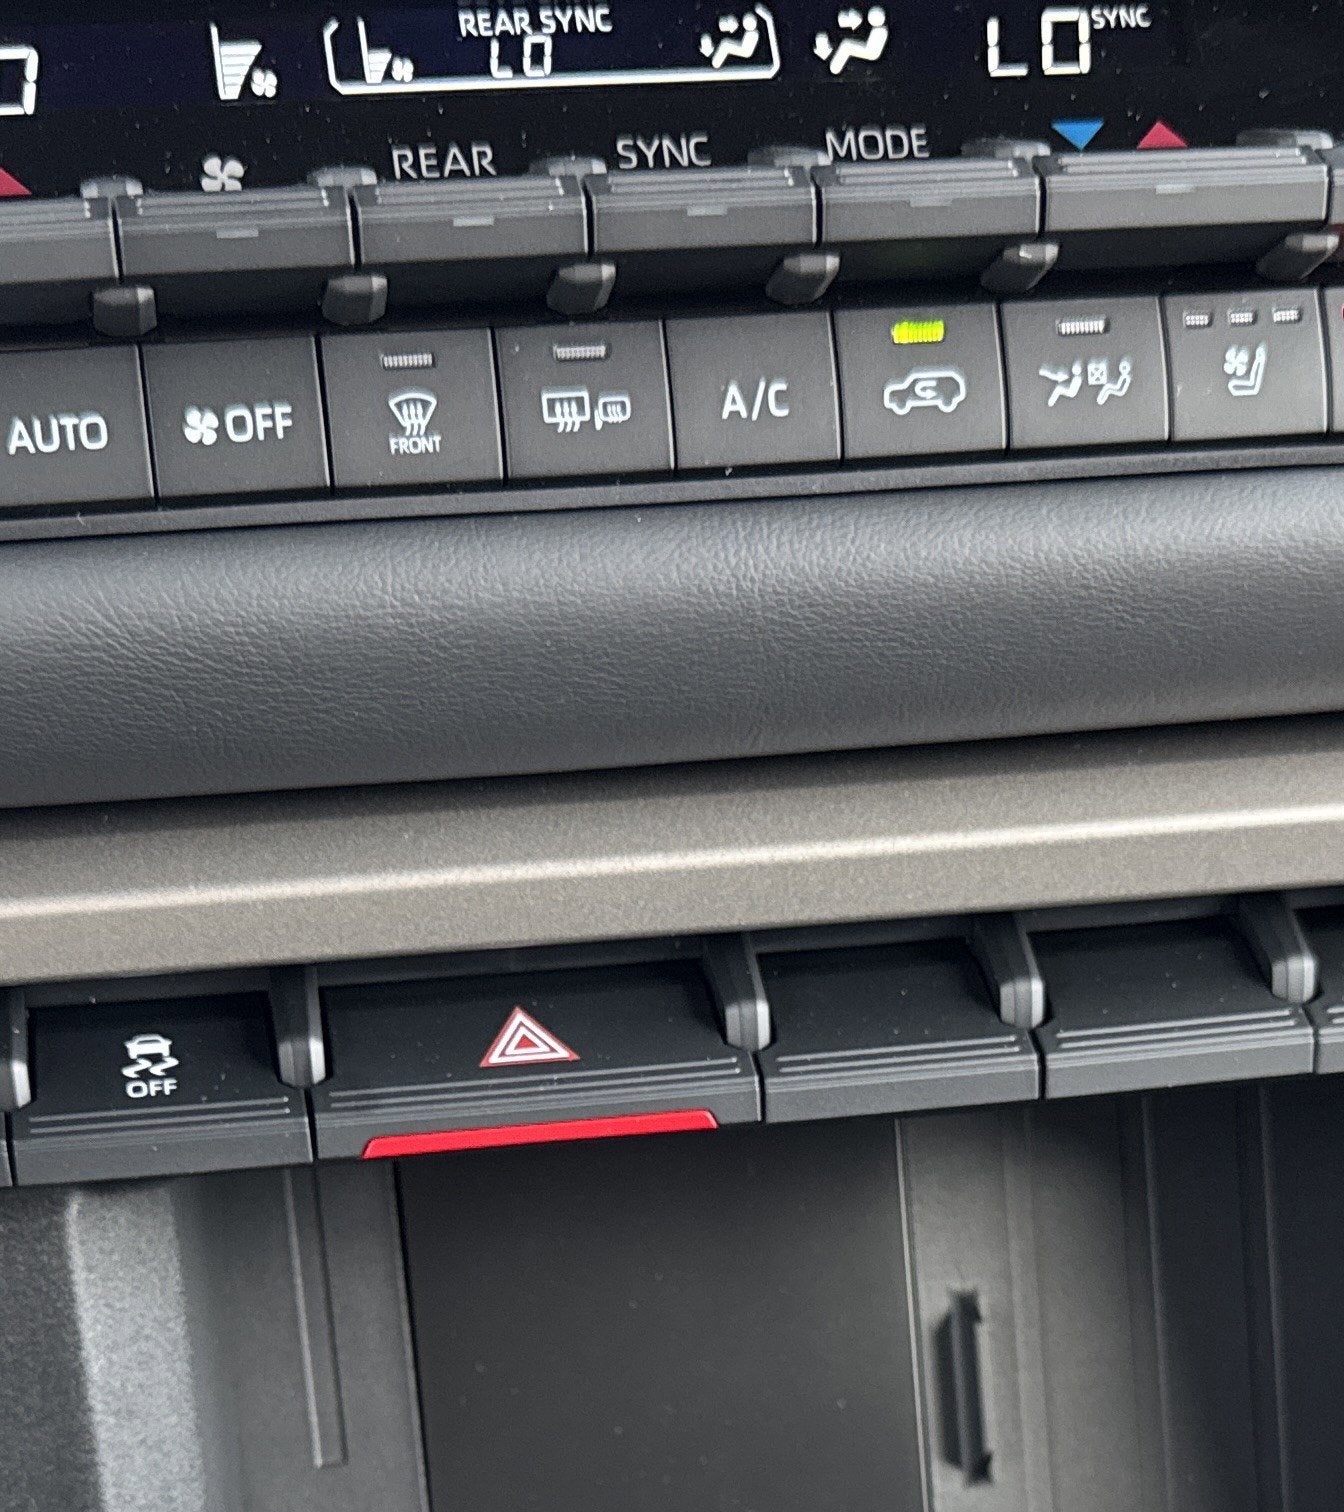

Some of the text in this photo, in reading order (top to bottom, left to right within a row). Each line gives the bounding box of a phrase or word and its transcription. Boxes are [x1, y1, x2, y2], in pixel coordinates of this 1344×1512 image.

[458, 7, 613, 37] REAR SYNC
[489, 34, 553, 79] LO
[986, 5, 1152, 78] LO SYNC
[391, 144, 497, 178] REAR
[616, 134, 712, 170] SYNC
[825, 125, 930, 161] MODE
[721, 380, 790, 419] A/C
[8, 414, 108, 454] AUTO
[224, 404, 293, 443] OFF
[389, 434, 442, 455] FRONT
[125, 1078, 179, 1098] OFF
